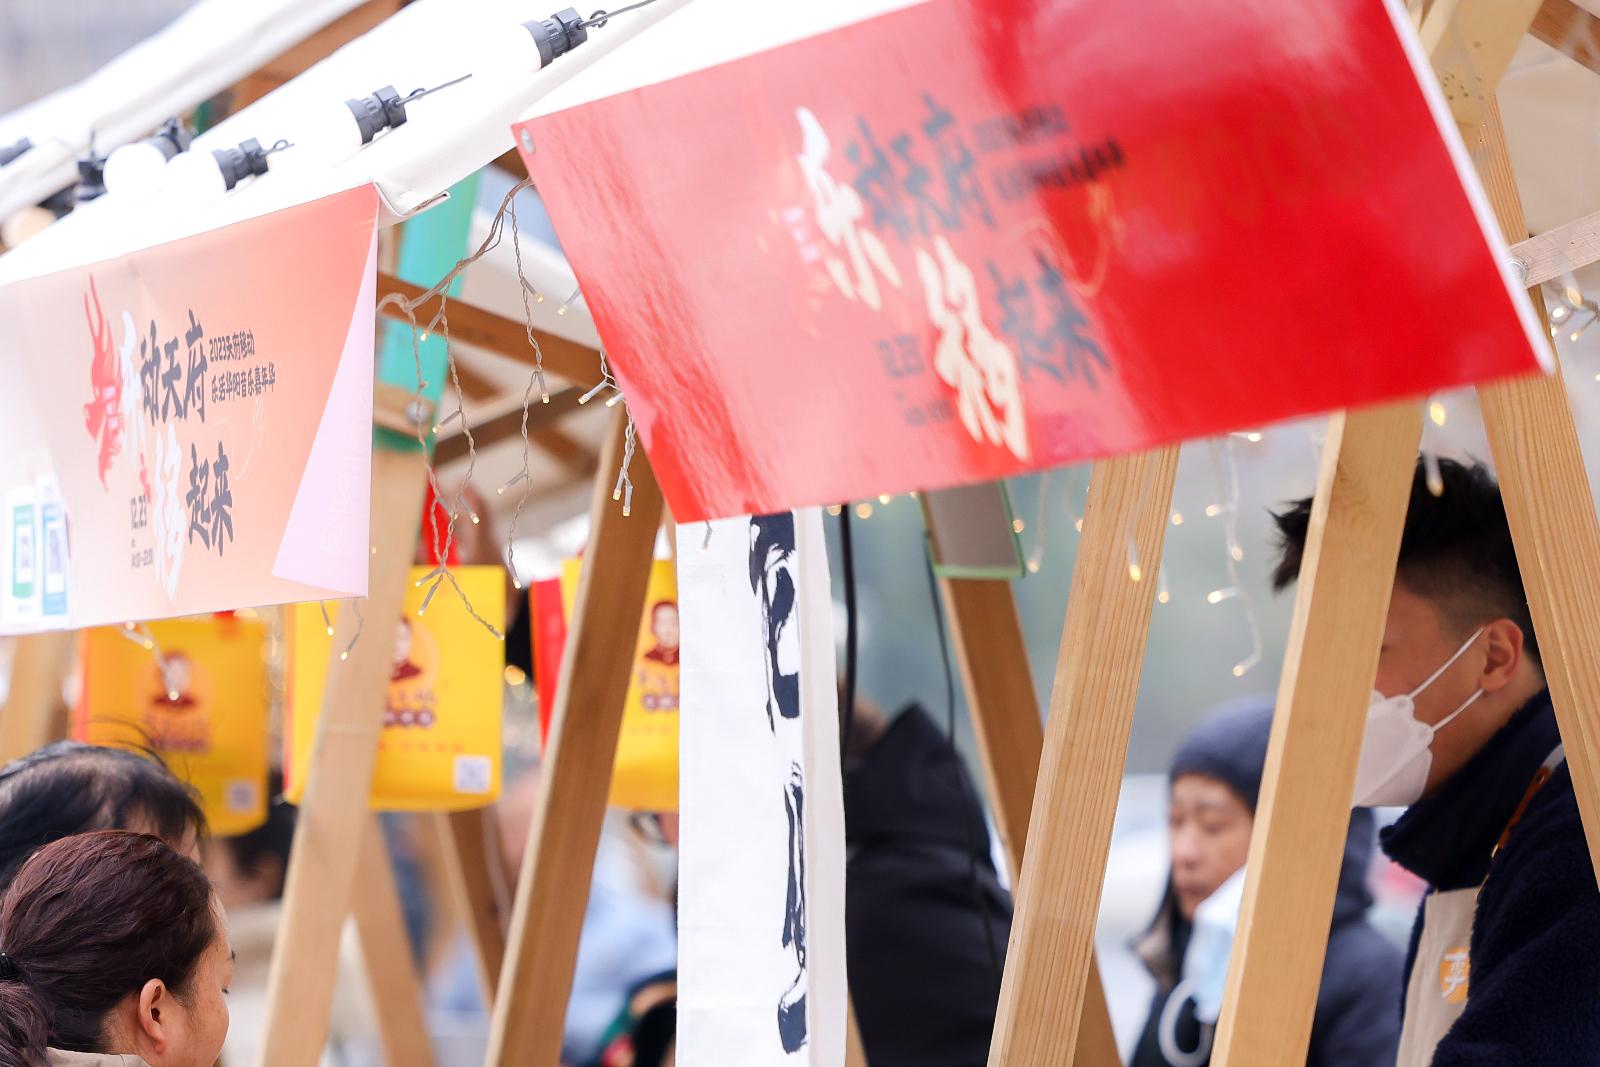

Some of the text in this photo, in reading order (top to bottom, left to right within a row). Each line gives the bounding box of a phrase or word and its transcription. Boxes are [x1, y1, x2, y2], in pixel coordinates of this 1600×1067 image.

[209, 329, 255, 362] 2023天府移动
[211, 361, 276, 404] 乐活华阳音乐嘉年华
